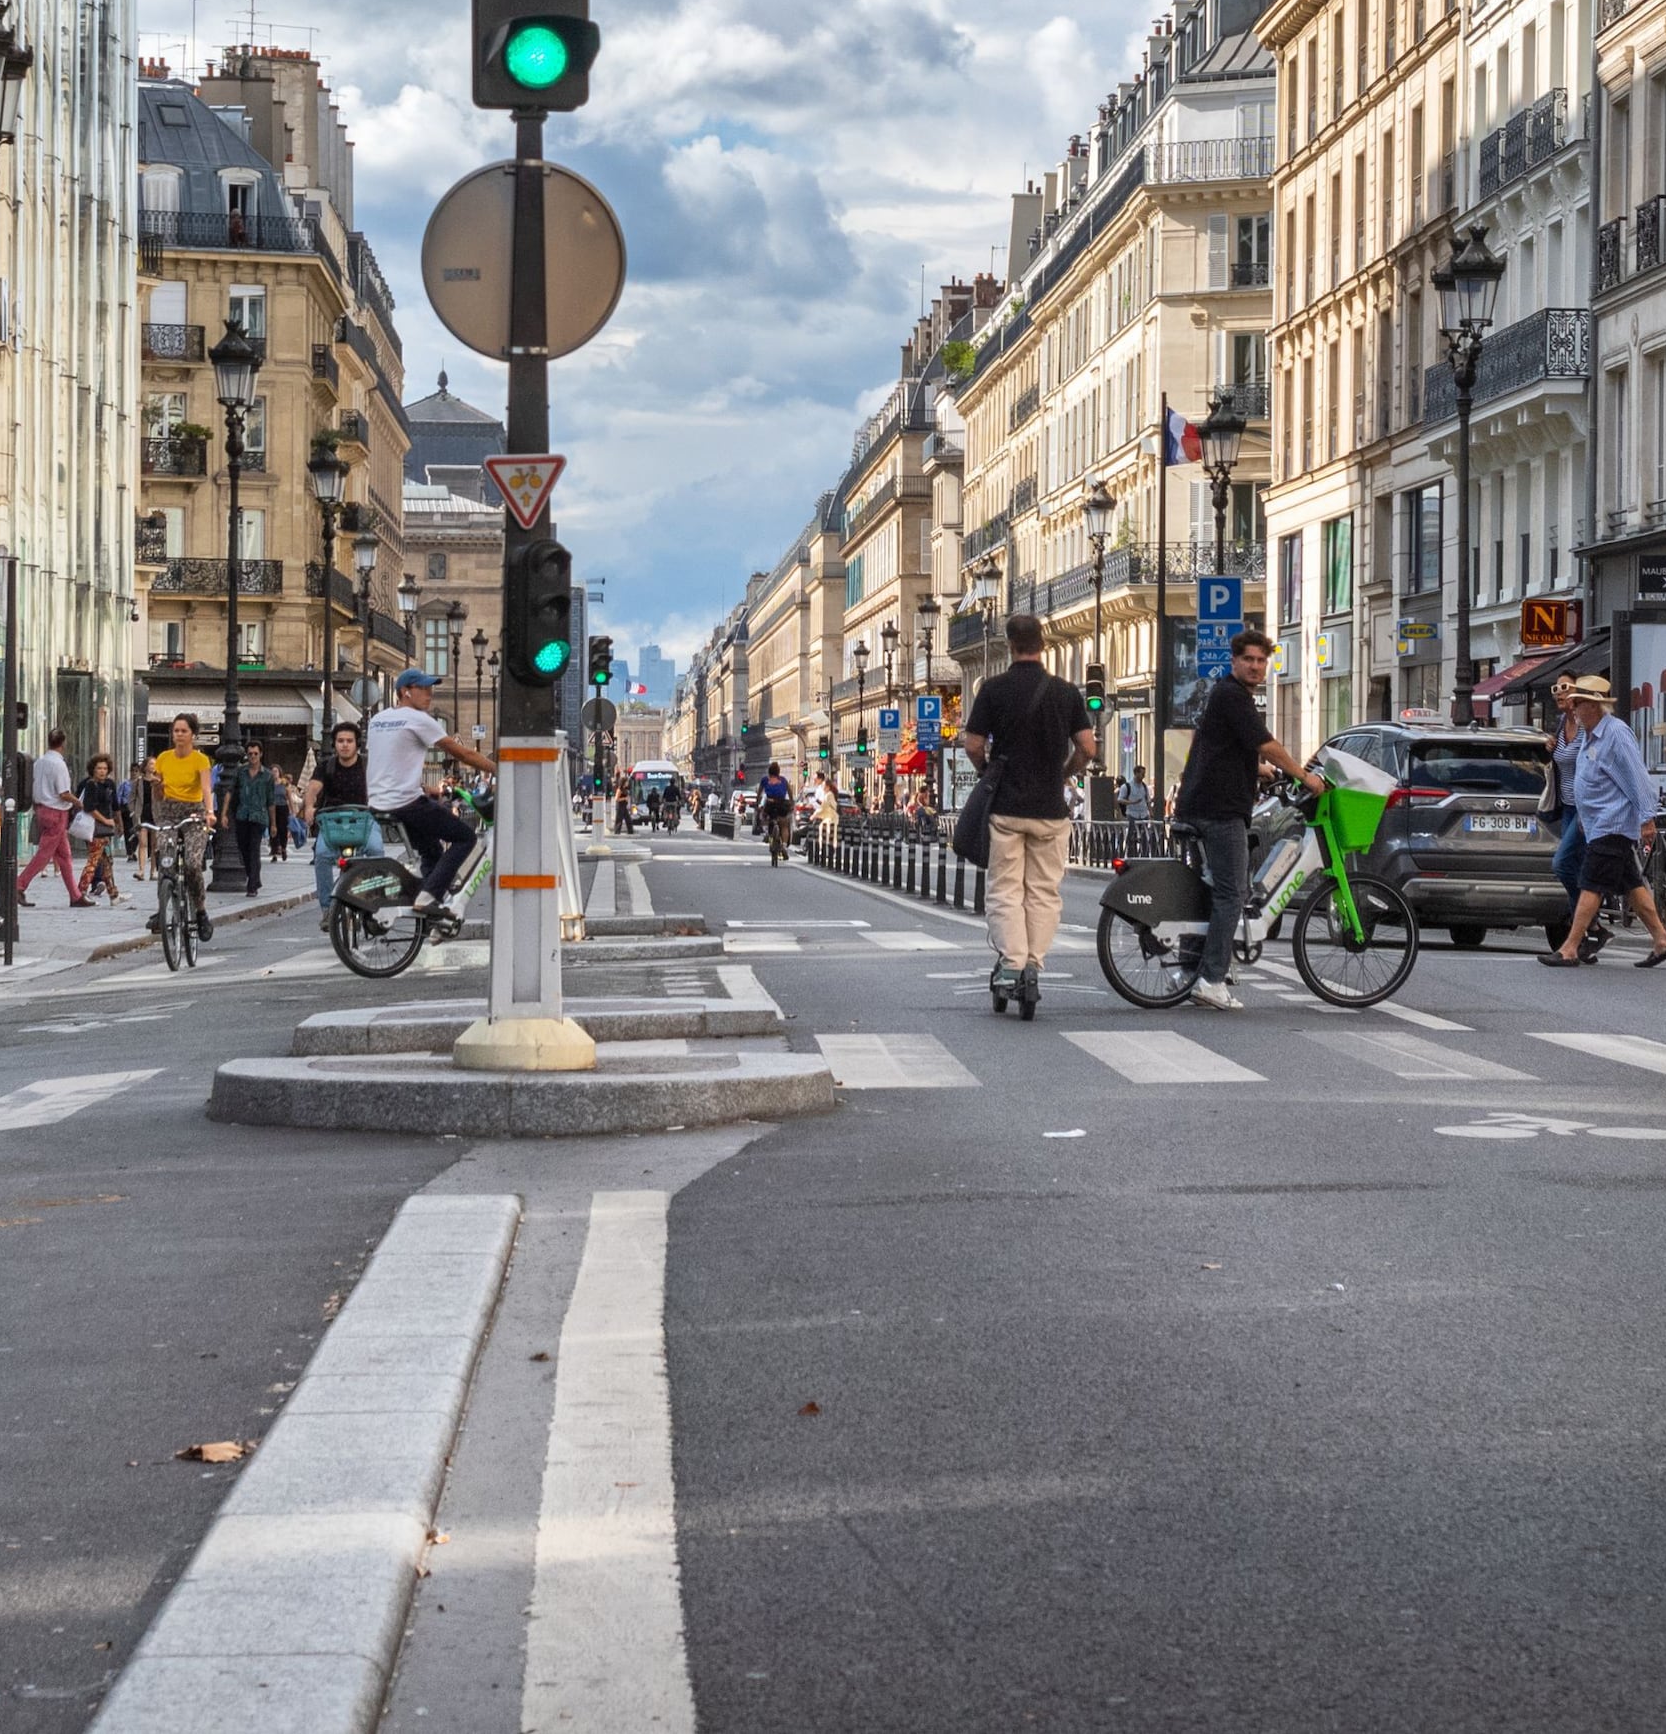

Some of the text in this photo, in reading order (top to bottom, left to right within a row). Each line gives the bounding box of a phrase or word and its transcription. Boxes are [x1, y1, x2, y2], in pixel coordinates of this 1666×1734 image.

[1210, 584, 1230, 613] P
[1532, 606, 1558, 632] N
[1403, 627, 1435, 635] IKEA
[1220, 638, 1230, 646] GA
[1525, 634, 1565, 642] NICOLAS
[1202, 651, 1230, 661] 24h/2
[924, 701, 935, 716] P
[1412, 709, 1432, 717] TAXI
[885, 713, 894, 725] P
[1127, 893, 1153, 905] Lime
[1269, 869, 1306, 917] Lime
